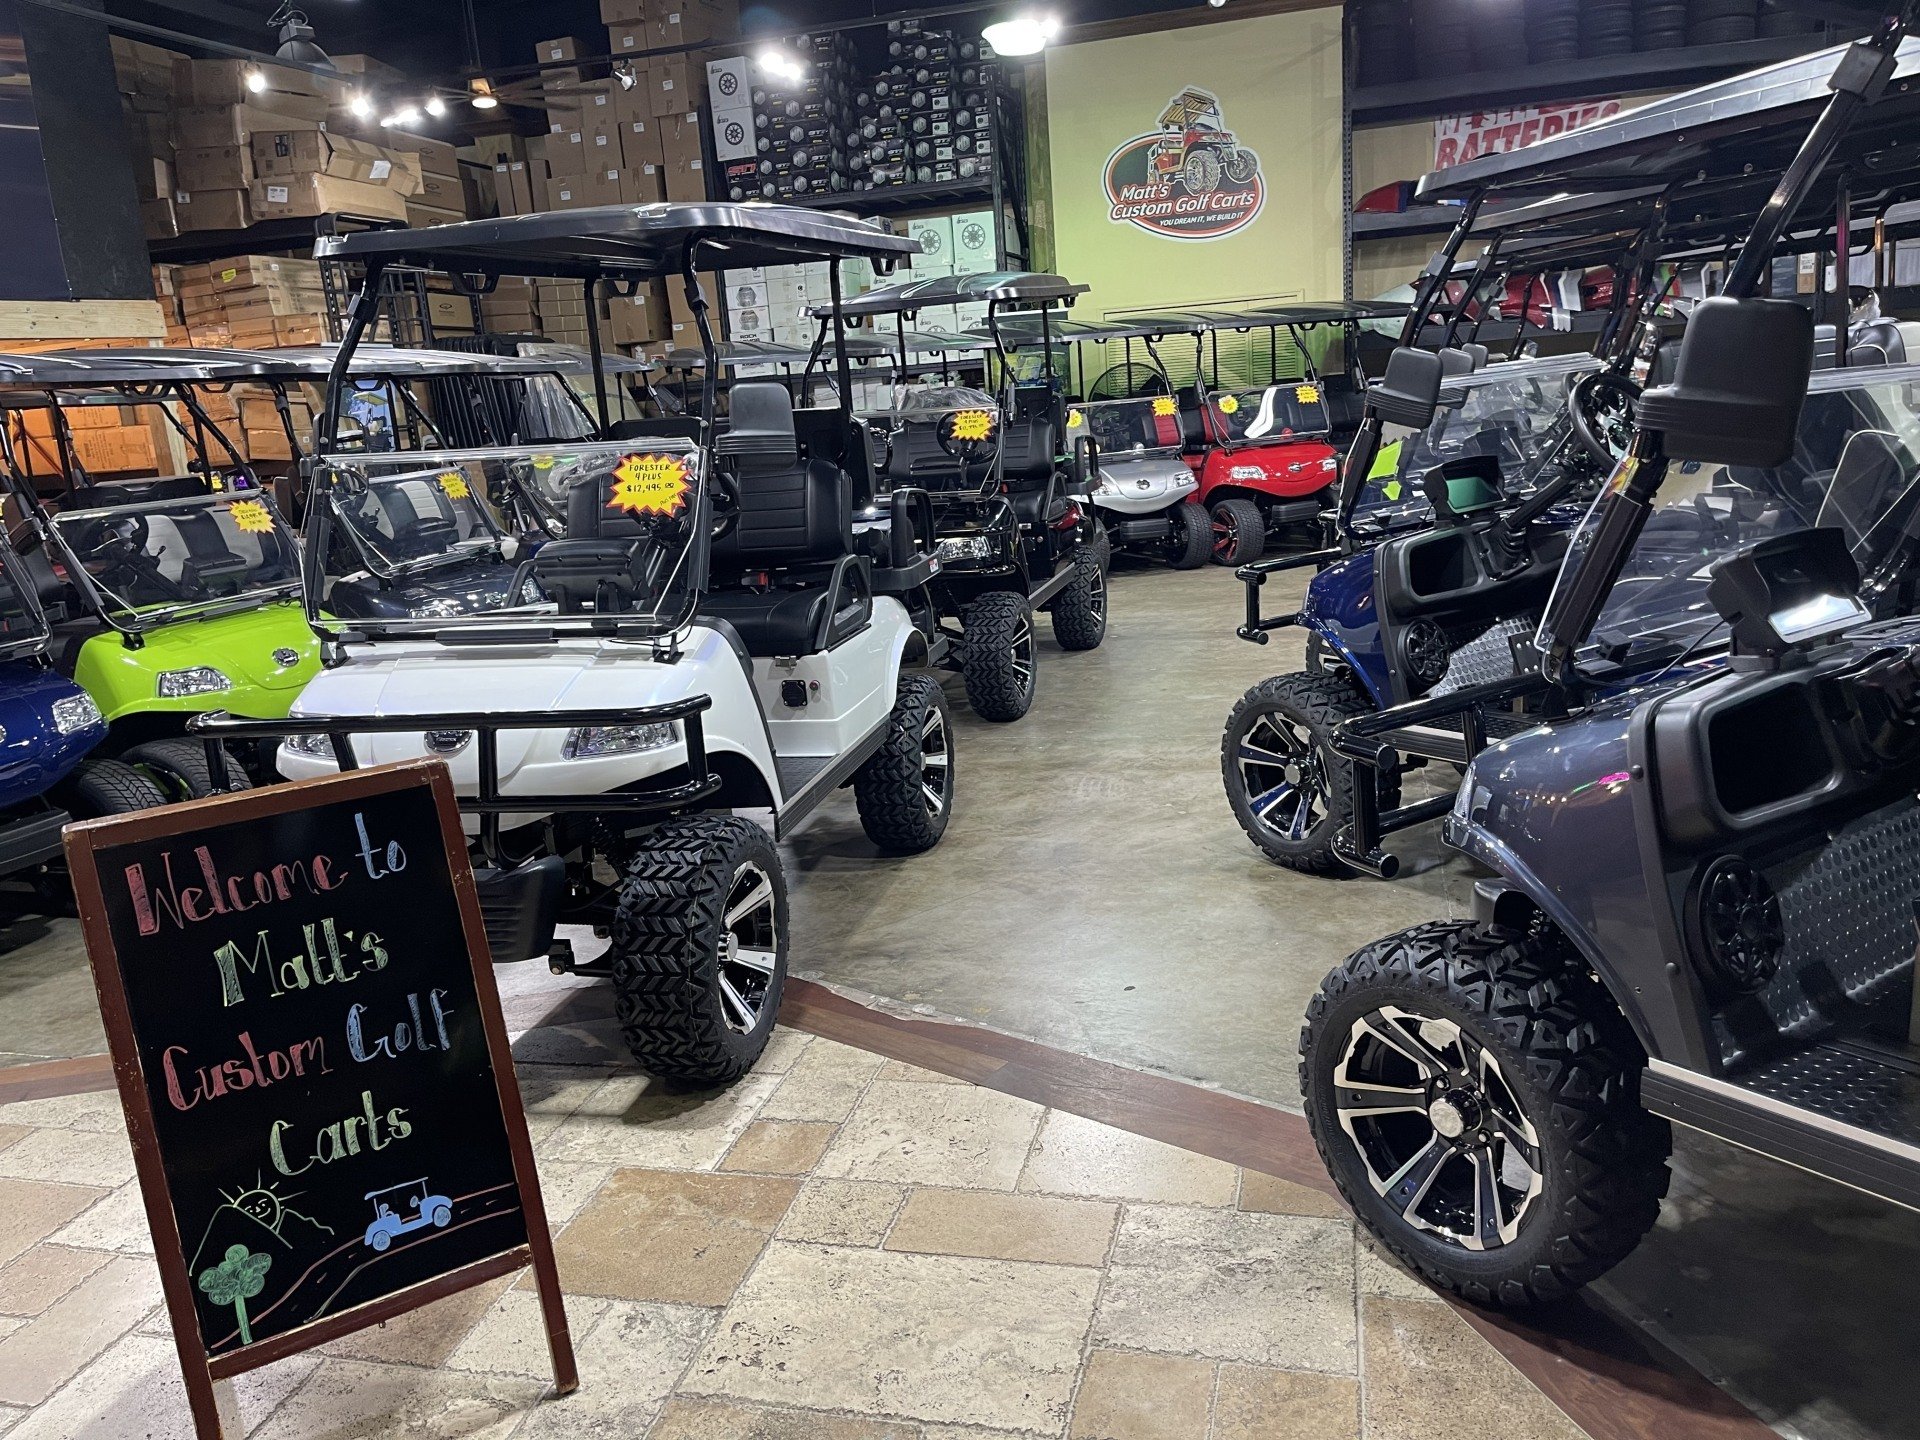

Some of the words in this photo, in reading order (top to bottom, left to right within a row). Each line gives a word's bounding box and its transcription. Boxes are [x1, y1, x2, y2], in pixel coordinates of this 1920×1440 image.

[1112, 202, 1172, 219] Custom
[1175, 194, 1211, 212] Golf
[1211, 191, 1255, 208] Carts
[1120, 184, 1169, 201] Matt's
[1174, 217, 1197, 225] DREAM
[1197, 215, 1206, 223] IT,
[1237, 211, 1244, 219] IT
[629, 464, 671, 472] FORESTER
[635, 472, 640, 480] 4
[642, 472, 662, 481] PLUS
[125, 845, 348, 937] Welcome
[355, 812, 407, 880] to
[213, 917, 389, 1007] Matt's
[162, 1031, 334, 1111] Custom
[346, 988, 454, 1063] Golf
[269, 1090, 412, 1176] Carts
